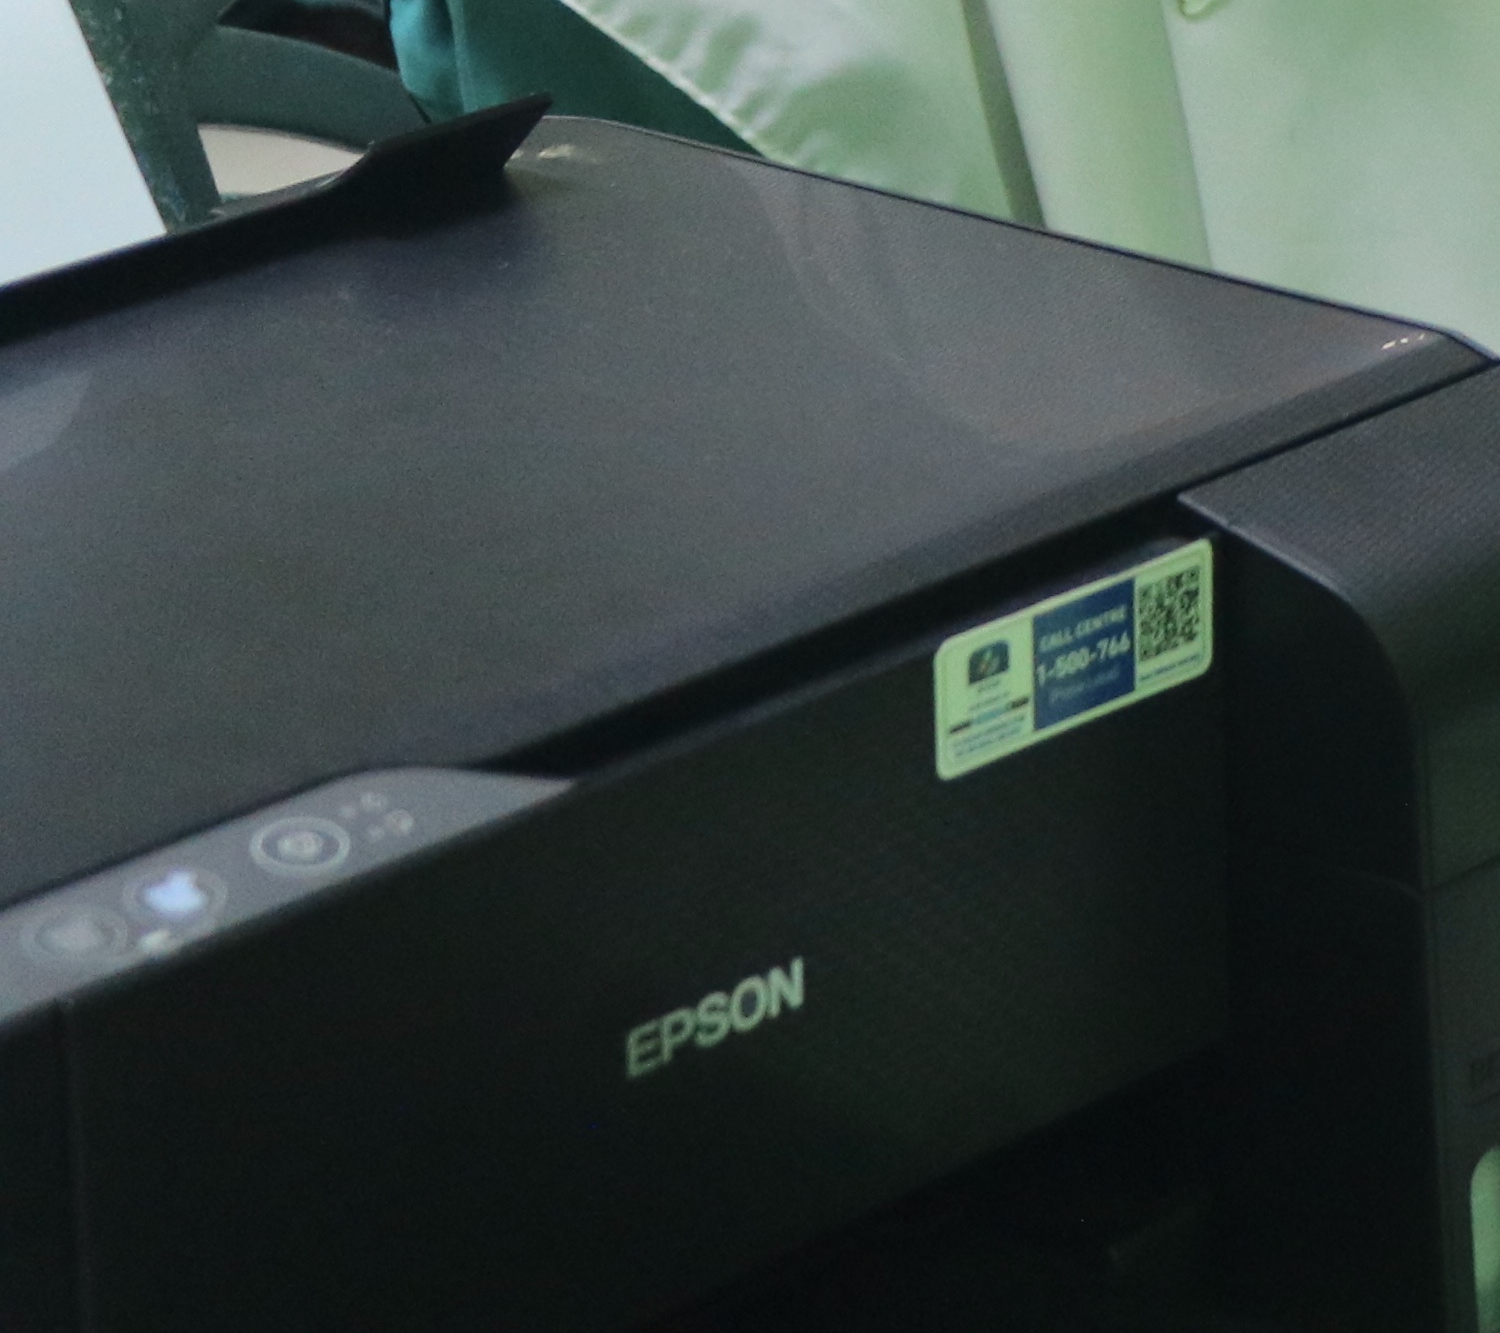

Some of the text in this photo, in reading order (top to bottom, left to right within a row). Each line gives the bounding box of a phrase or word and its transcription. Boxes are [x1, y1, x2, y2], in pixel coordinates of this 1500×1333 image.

[1037, 604, 1128, 653] CALL CENTRE
[1036, 631, 1131, 687] 1-500-766
[626, 955, 804, 1078] EPSON
